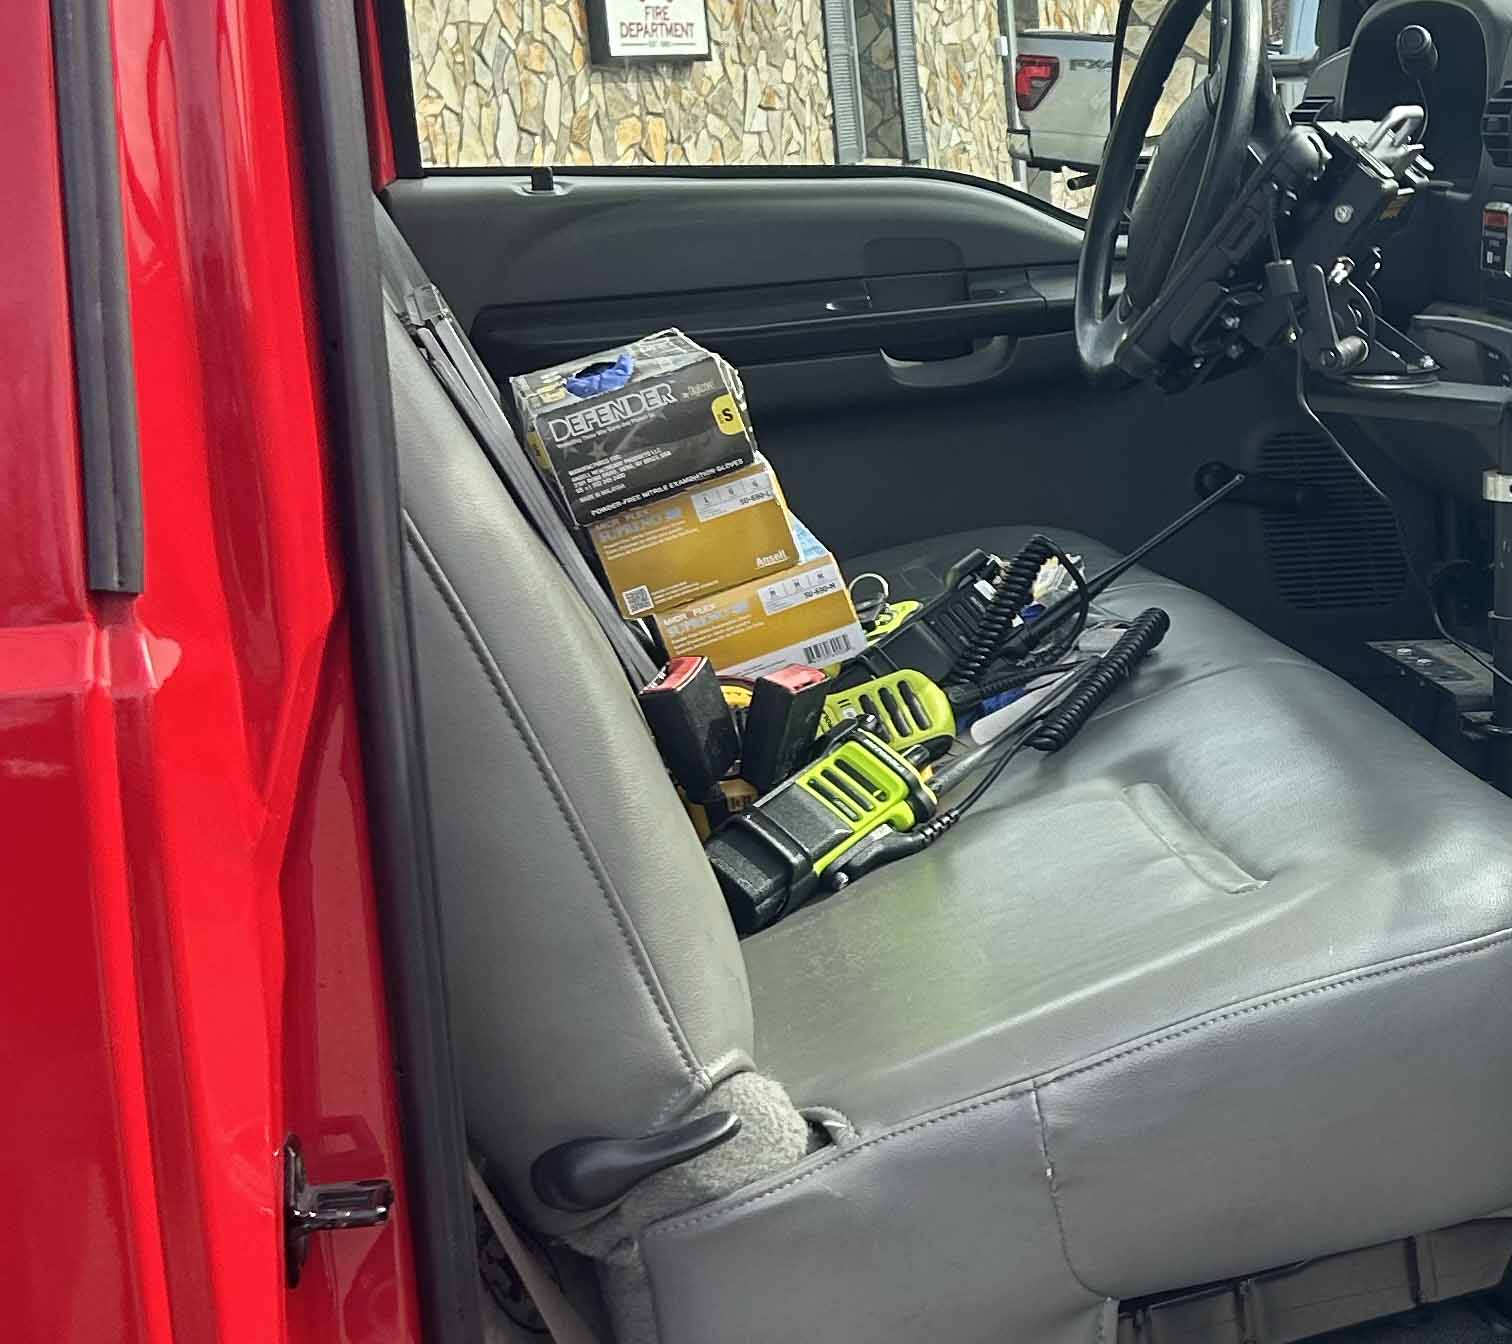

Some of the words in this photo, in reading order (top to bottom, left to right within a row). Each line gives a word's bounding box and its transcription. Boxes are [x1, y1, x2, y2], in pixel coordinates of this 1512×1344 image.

[644, 6, 670, 21] FIRE
[619, 22, 695, 39] DEPARTMENT
[549, 382, 679, 443] DEFENDER
[722, 408, 734, 422] S
[642, 483, 669, 499] NITRILE
[669, 467, 716, 490] EXAMINATION
[716, 457, 744, 473] GLOVES
[756, 549, 788, 568] Ansell
